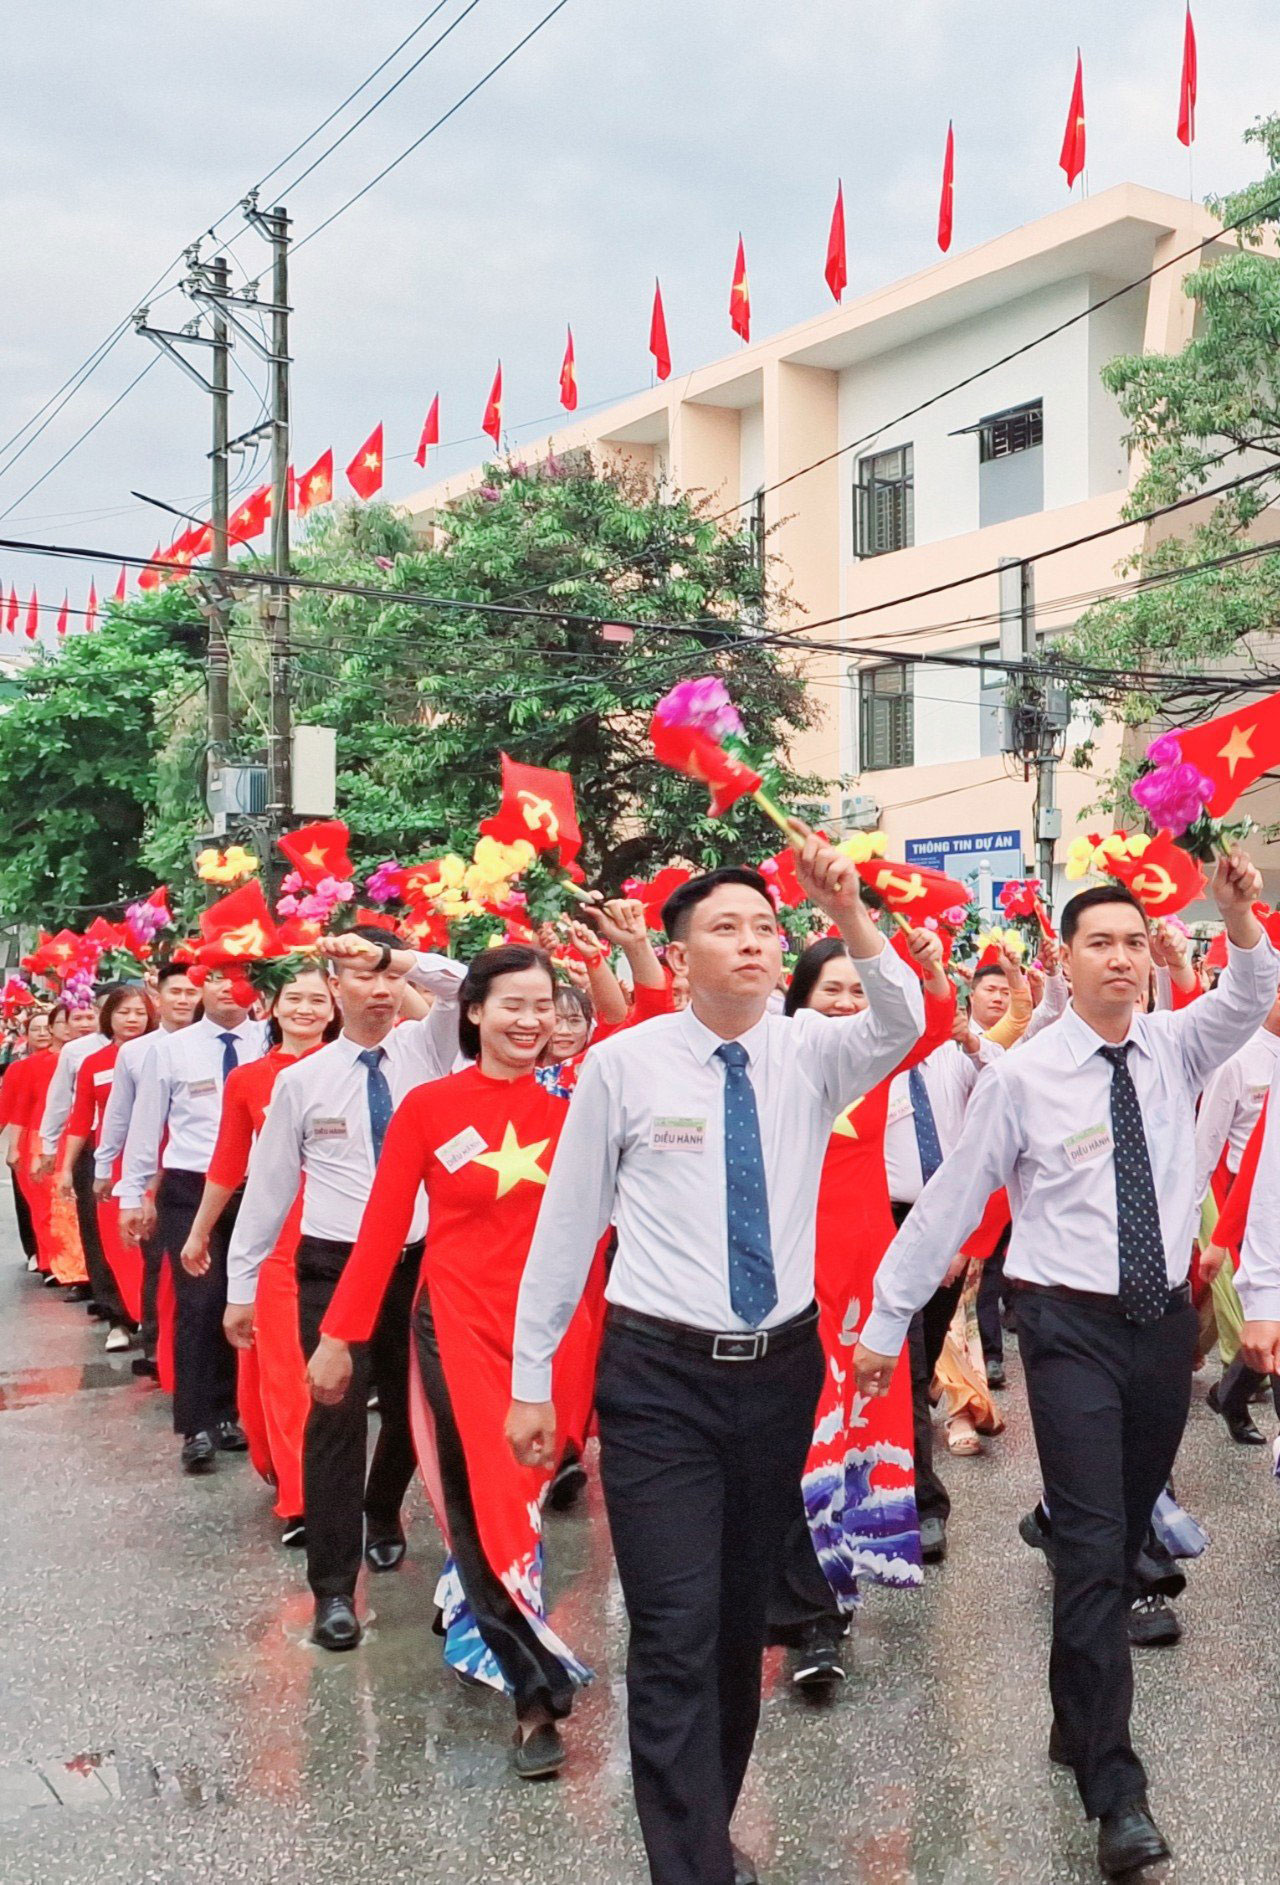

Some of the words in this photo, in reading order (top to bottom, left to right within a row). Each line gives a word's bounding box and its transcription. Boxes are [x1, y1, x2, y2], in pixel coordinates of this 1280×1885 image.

[912, 840, 950, 854] THÔNG
[953, 840, 972, 852] TIN
[975, 836, 994, 851] DỰ
[995, 835, 1013, 848] ÁN
[677, 1133, 703, 1144] HÀNH
